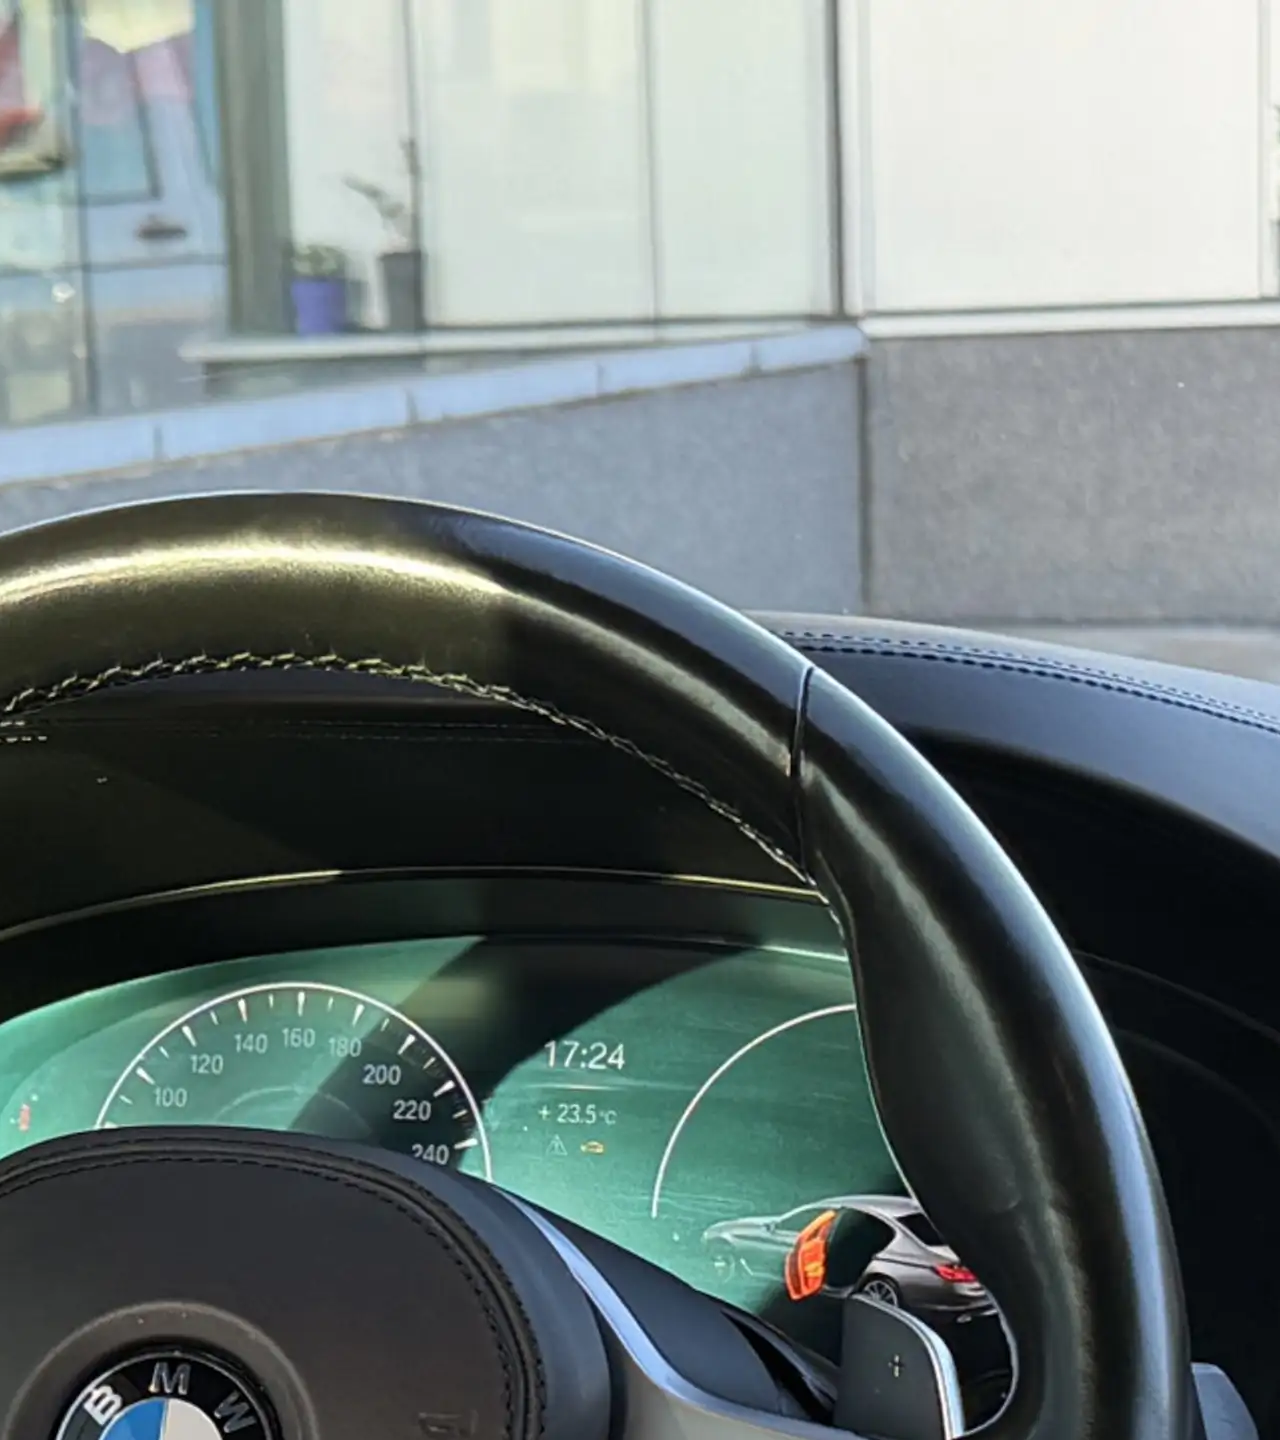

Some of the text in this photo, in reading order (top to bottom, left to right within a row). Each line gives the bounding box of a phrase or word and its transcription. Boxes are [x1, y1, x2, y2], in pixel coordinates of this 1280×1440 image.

[235, 1033, 269, 1054] 140
[283, 1028, 316, 1048] 160
[328, 1037, 362, 1058] 180
[190, 1054, 224, 1076] 120
[543, 1040, 626, 1070] 17:24
[363, 1064, 401, 1086] 200
[154, 1087, 188, 1108] 100
[392, 1100, 432, 1121] 220
[81, 1360, 258, 1434] BMW
